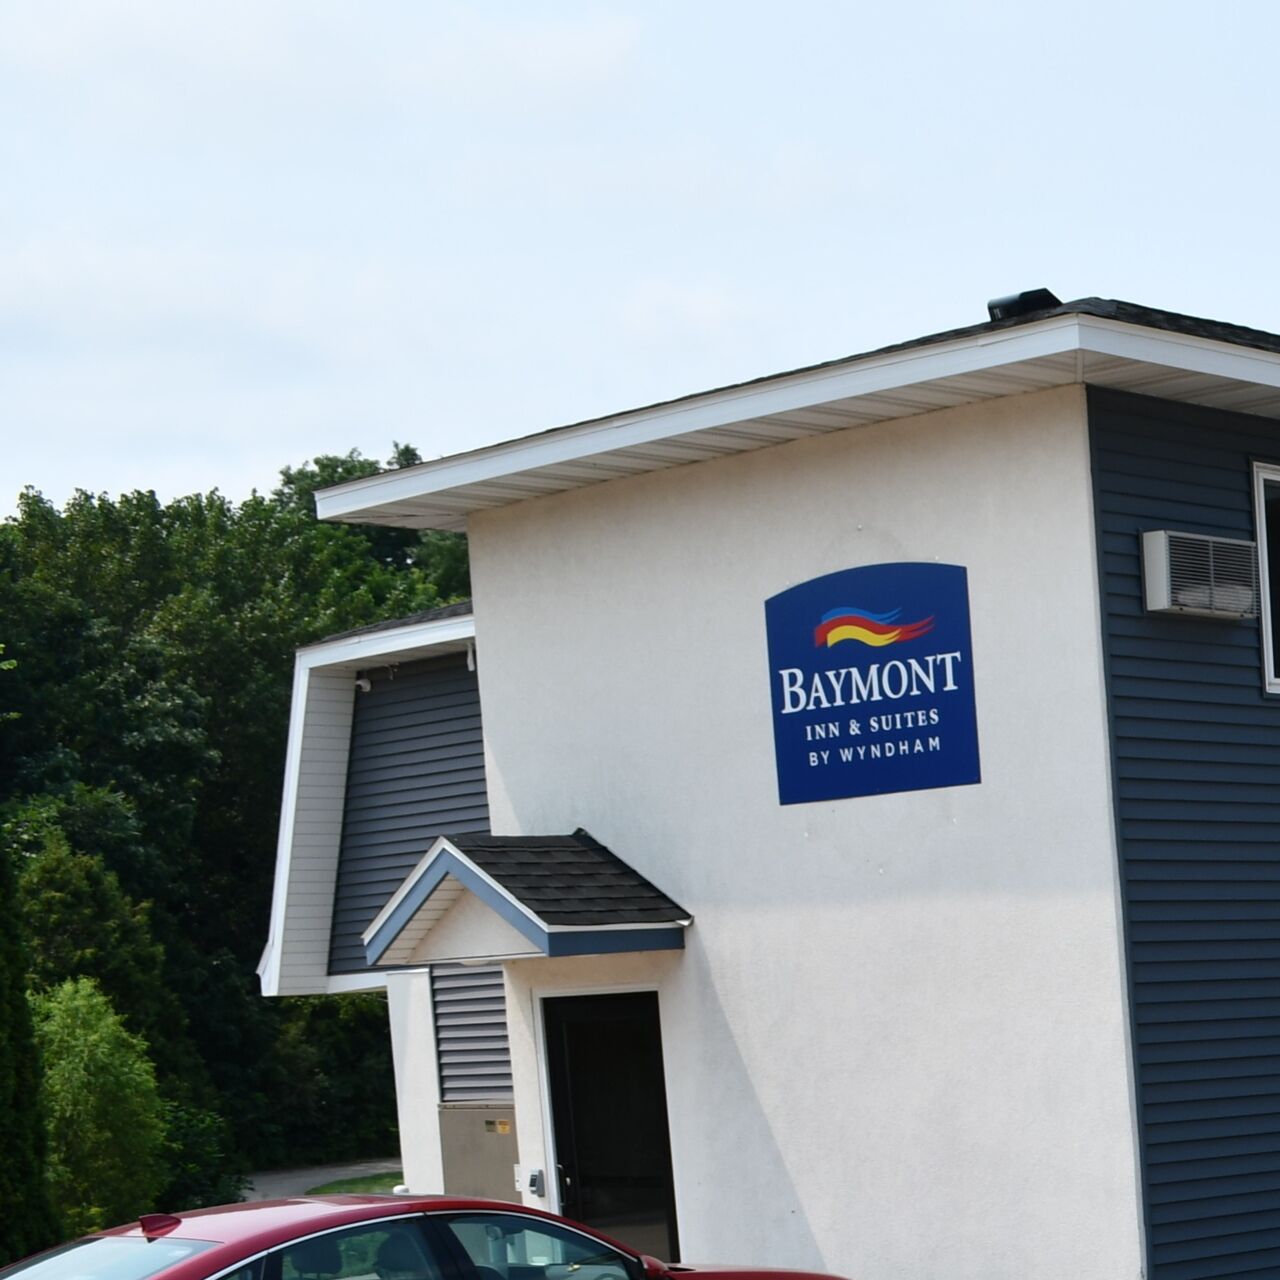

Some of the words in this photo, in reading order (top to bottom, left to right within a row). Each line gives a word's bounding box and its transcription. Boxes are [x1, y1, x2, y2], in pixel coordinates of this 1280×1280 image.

[778, 651, 962, 714] BAYMONT
[805, 721, 841, 741] INN
[849, 719, 861, 736] &
[869, 708, 940, 732] SUITES
[808, 750, 830, 767] BY
[839, 736, 941, 763] WYNDHAM
